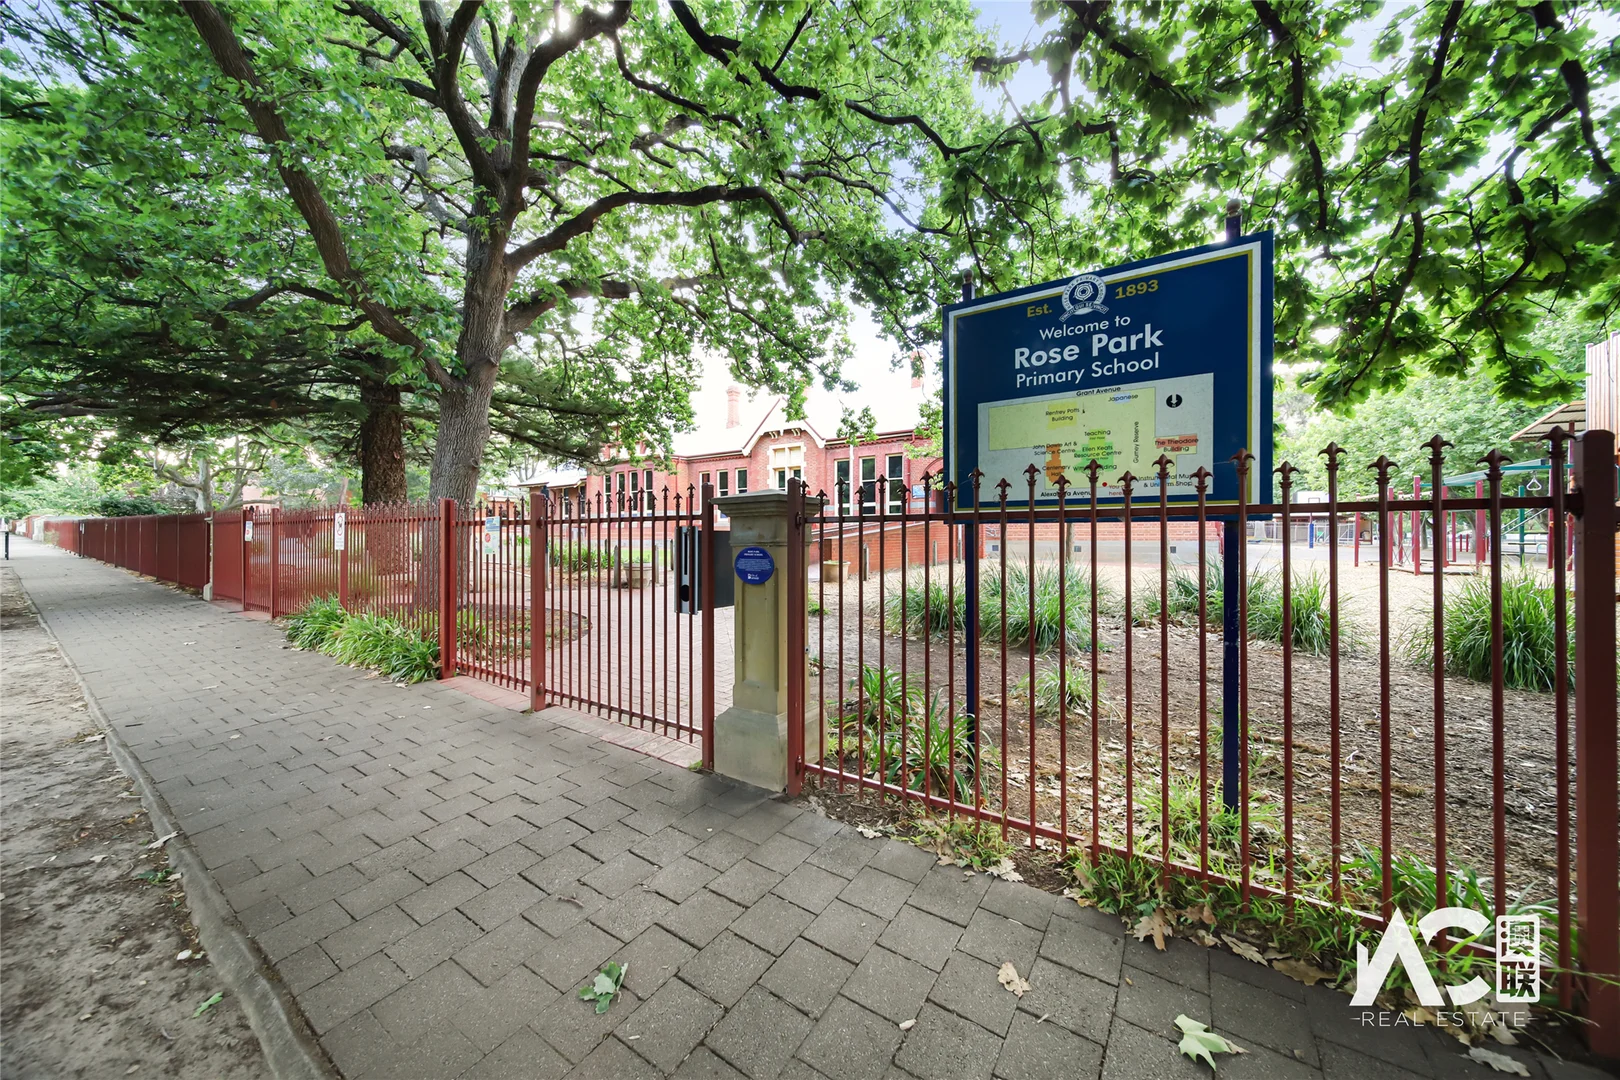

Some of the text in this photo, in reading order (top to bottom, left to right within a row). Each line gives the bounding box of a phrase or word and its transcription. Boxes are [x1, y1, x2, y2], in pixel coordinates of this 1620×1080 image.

[1027, 279, 1159, 318] Est. 1893
[1039, 315, 1131, 341] Welcome to
[1014, 323, 1164, 369] Rose Park
[1016, 351, 1159, 388] Primary School
[1076, 386, 1121, 397] Grant Avenue
[1108, 393, 1139, 402] Japanese
[1084, 429, 1111, 437] Teaching
[1132, 421, 1140, 443] Reserve
[1167, 437, 1199, 445] Theodore
